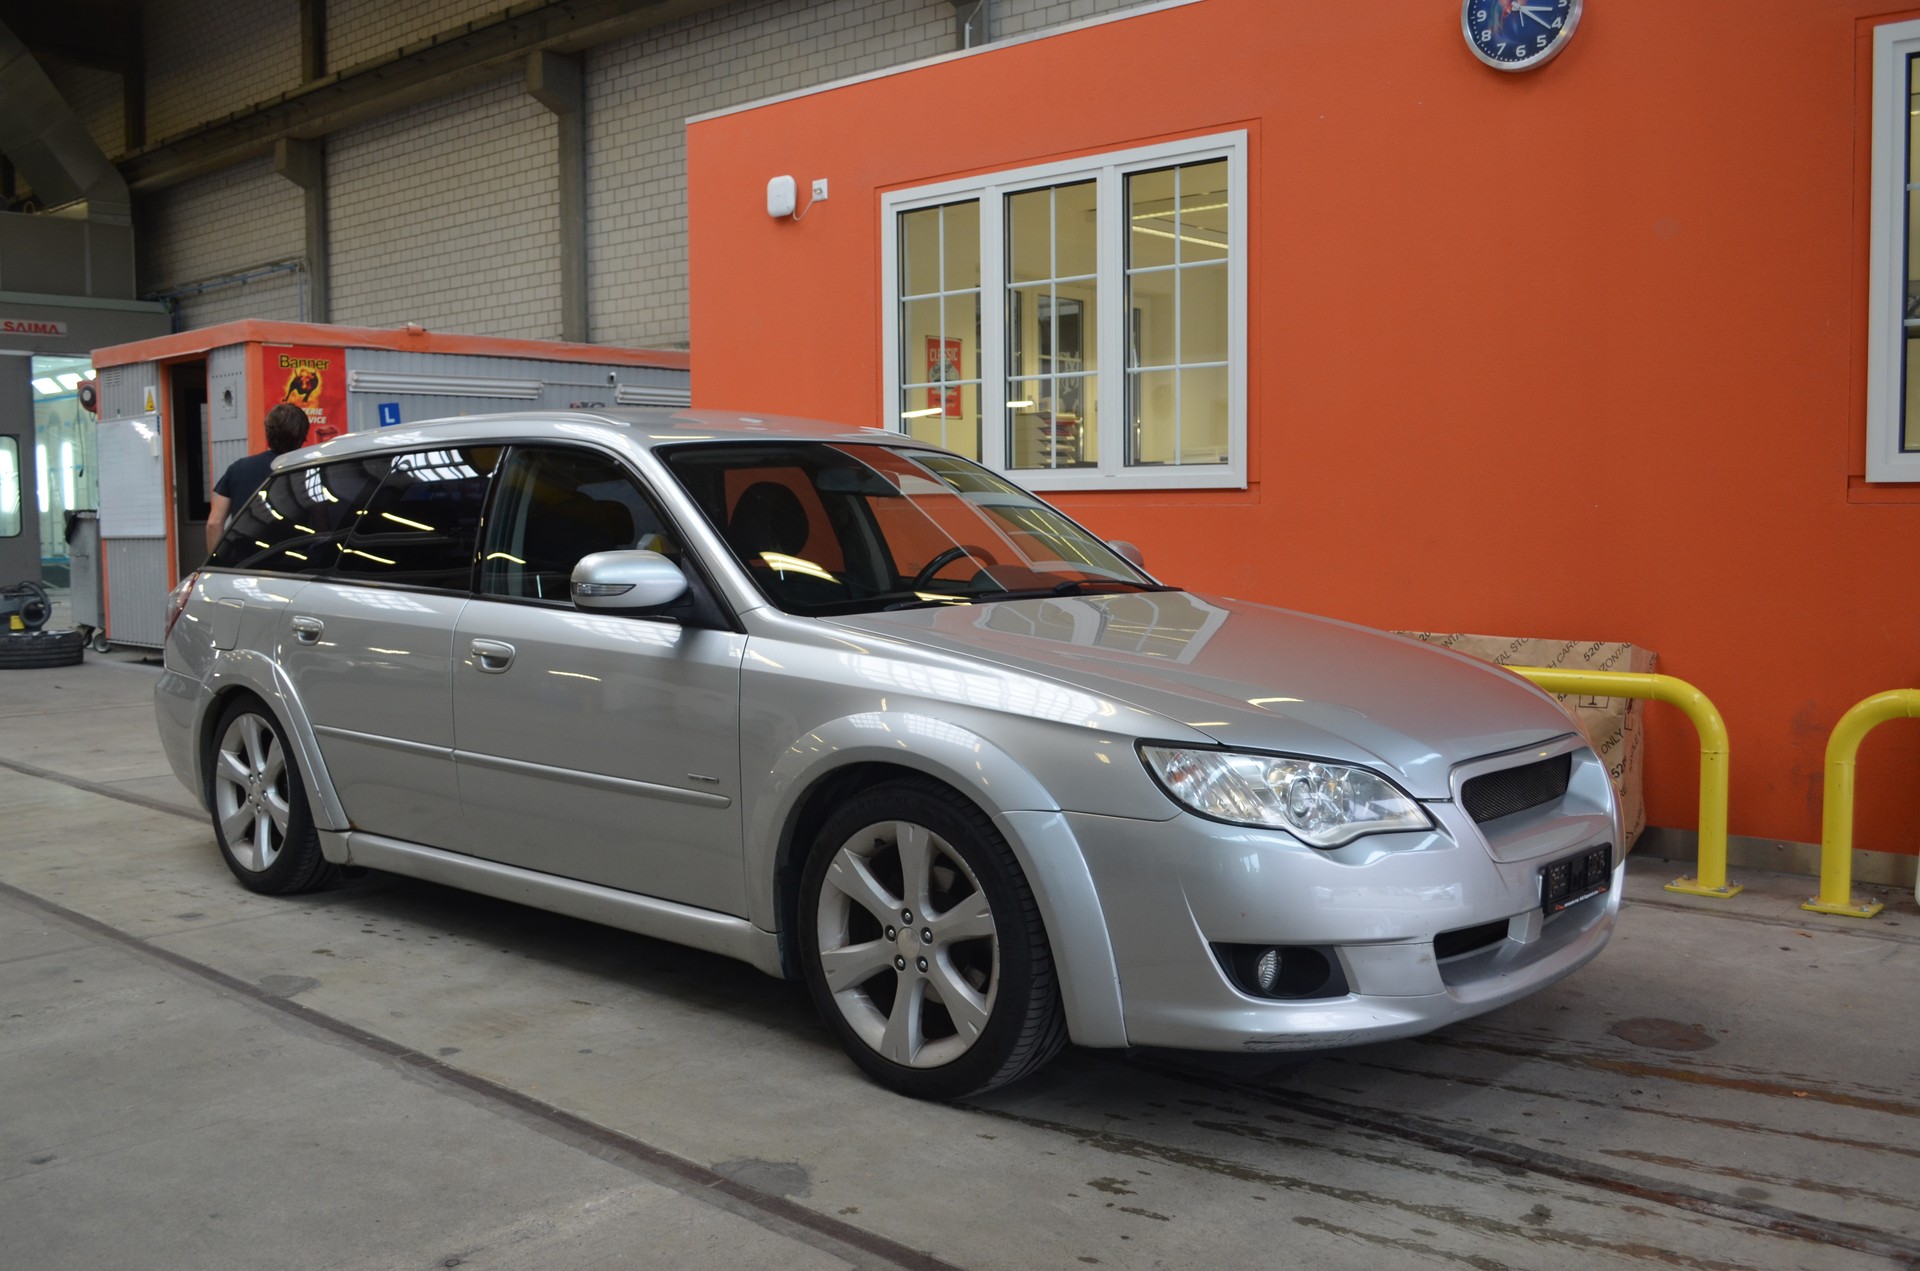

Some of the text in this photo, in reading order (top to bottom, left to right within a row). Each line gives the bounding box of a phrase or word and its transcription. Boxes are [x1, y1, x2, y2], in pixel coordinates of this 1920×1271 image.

[1476, 10, 1487, 22] 9
[1551, 17, 1562, 28] 4
[1481, 30, 1492, 41] 8
[1536, 35, 1547, 47] 5
[1496, 43, 1506, 55] 7
[1515, 45, 1526, 57] 6
[3, 320, 60, 335] SAIMA
[929, 347, 959, 362] CLASIC
[279, 354, 330, 370] Banner
[384, 407, 395, 423] L
[1600, 727, 1624, 754] ONLY
